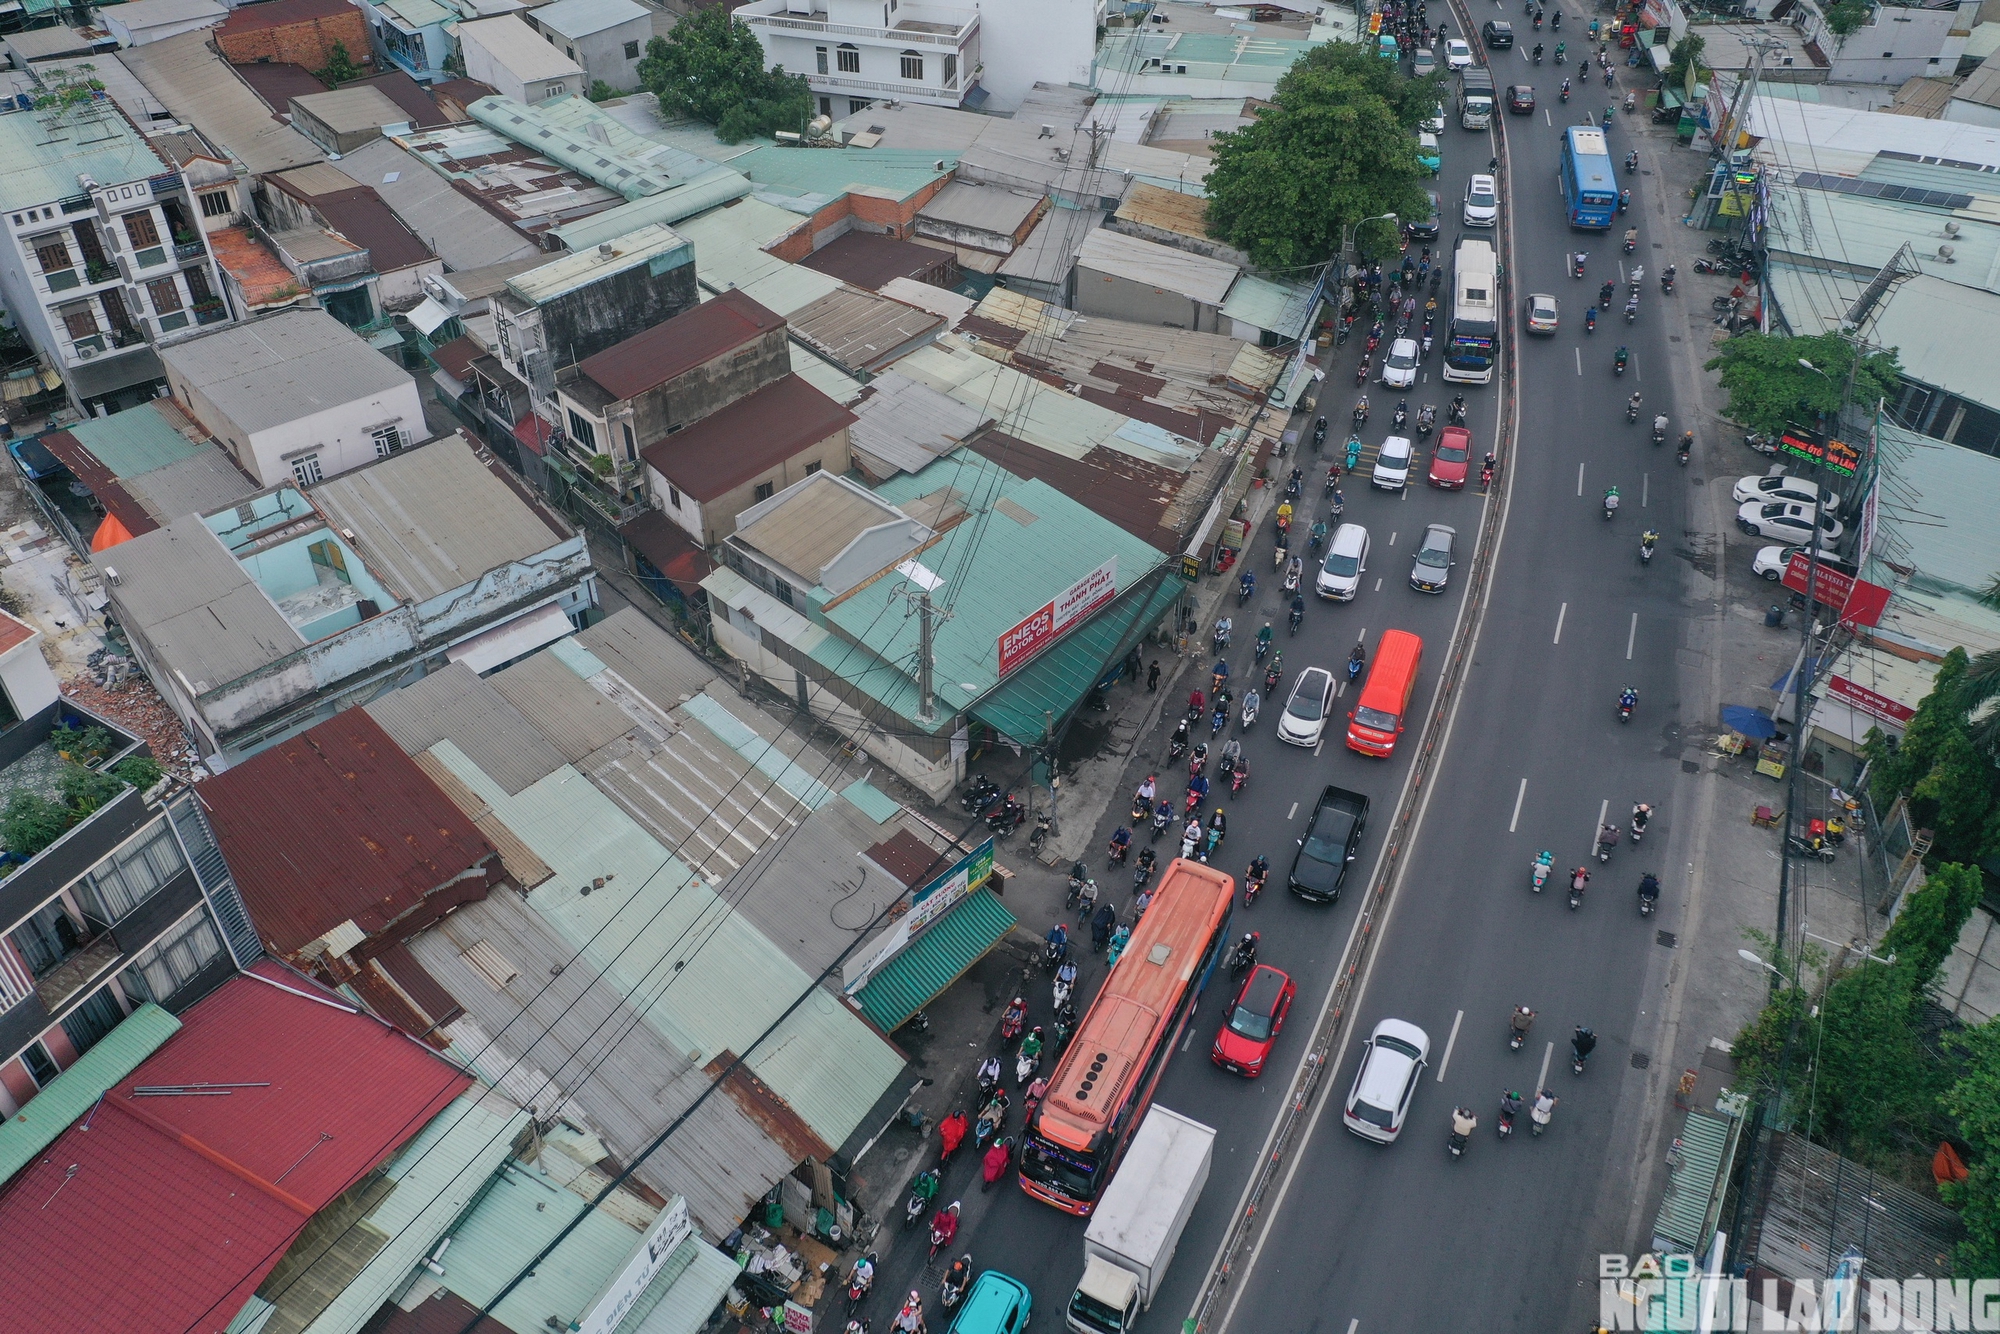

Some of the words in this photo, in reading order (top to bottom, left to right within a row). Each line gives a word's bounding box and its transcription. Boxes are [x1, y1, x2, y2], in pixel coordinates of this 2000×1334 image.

[1003, 610, 1050, 652] ENEOS
[1003, 634, 1034, 660] MOTOR
[1036, 624, 1049, 637] OIL
